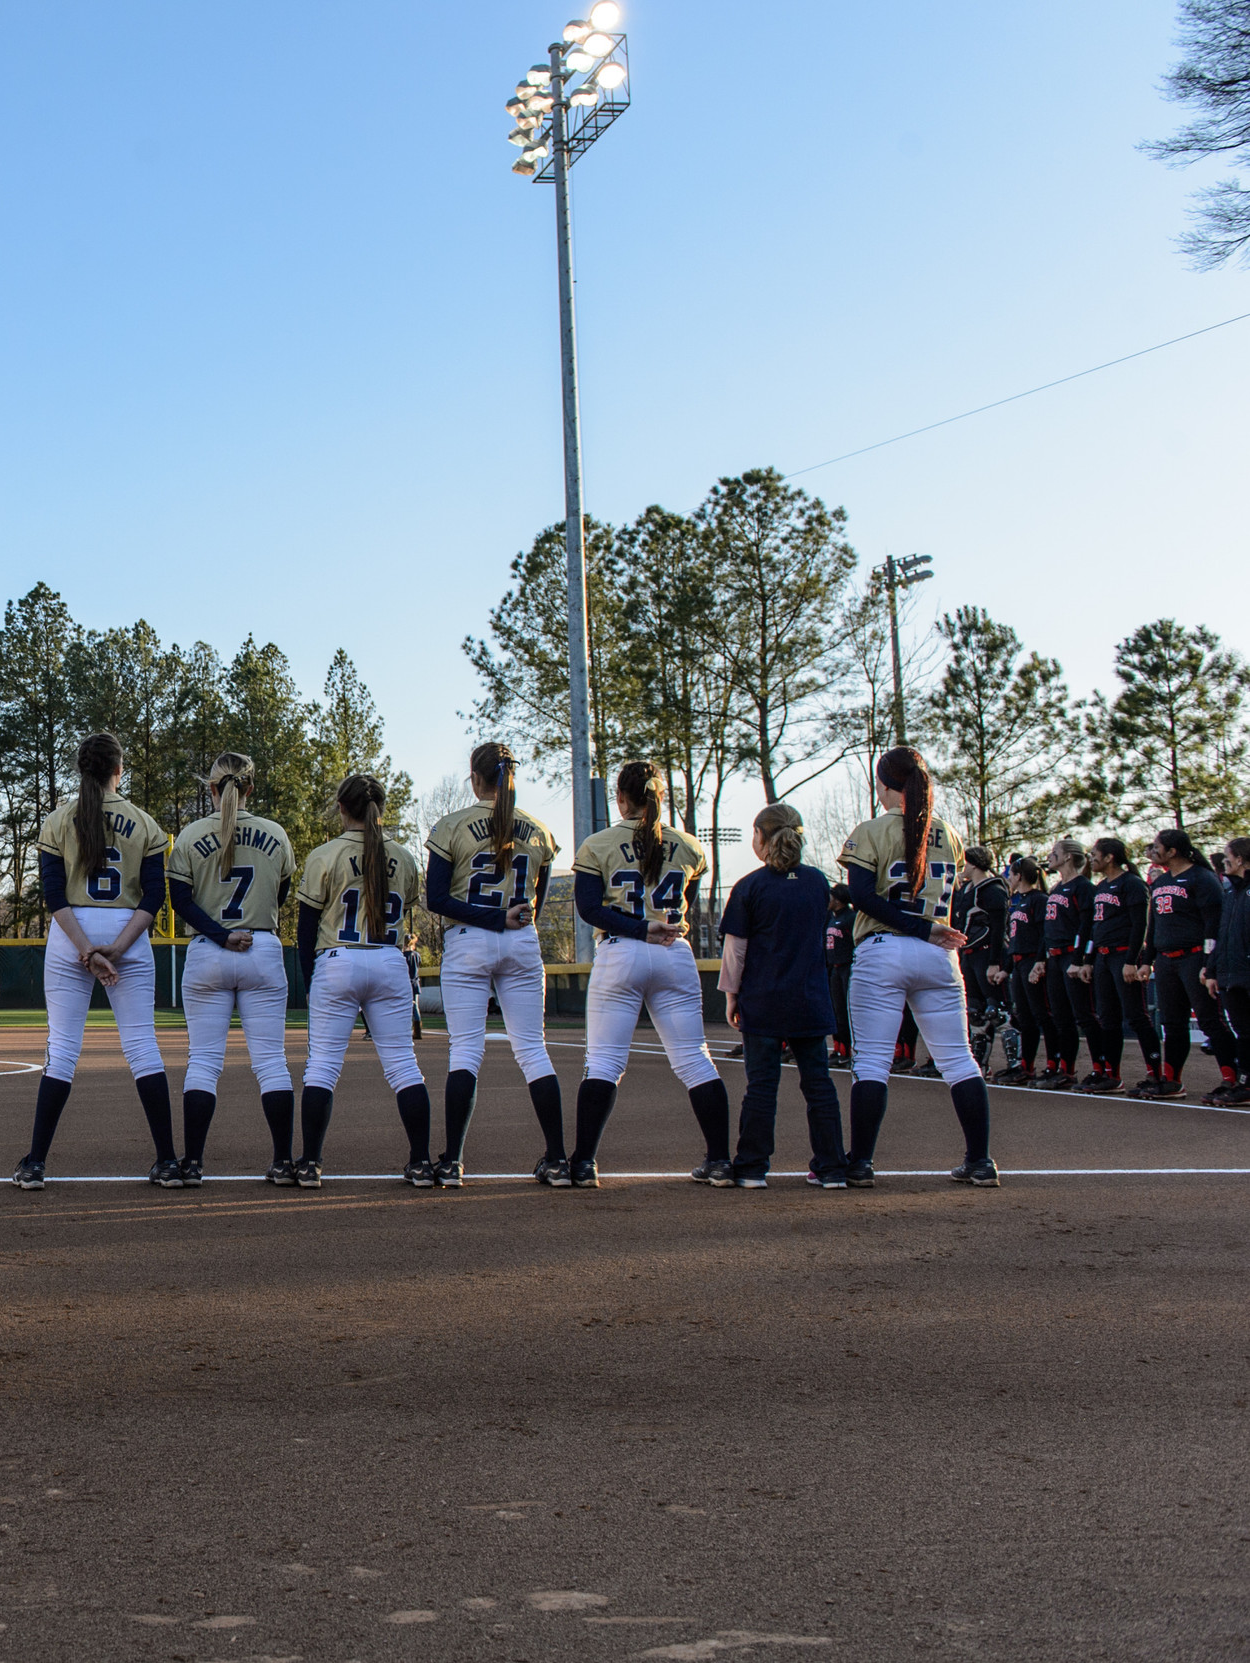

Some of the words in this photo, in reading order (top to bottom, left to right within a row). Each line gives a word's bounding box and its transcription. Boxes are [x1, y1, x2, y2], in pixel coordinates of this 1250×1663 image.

[86, 846, 122, 902] 6
[466, 851, 530, 909] 21
[620, 841, 679, 863] COEY
[218, 864, 255, 921] 7
[337, 888, 403, 946] 12
[610, 869, 686, 925] 34
[1155, 895, 1173, 914] 32
